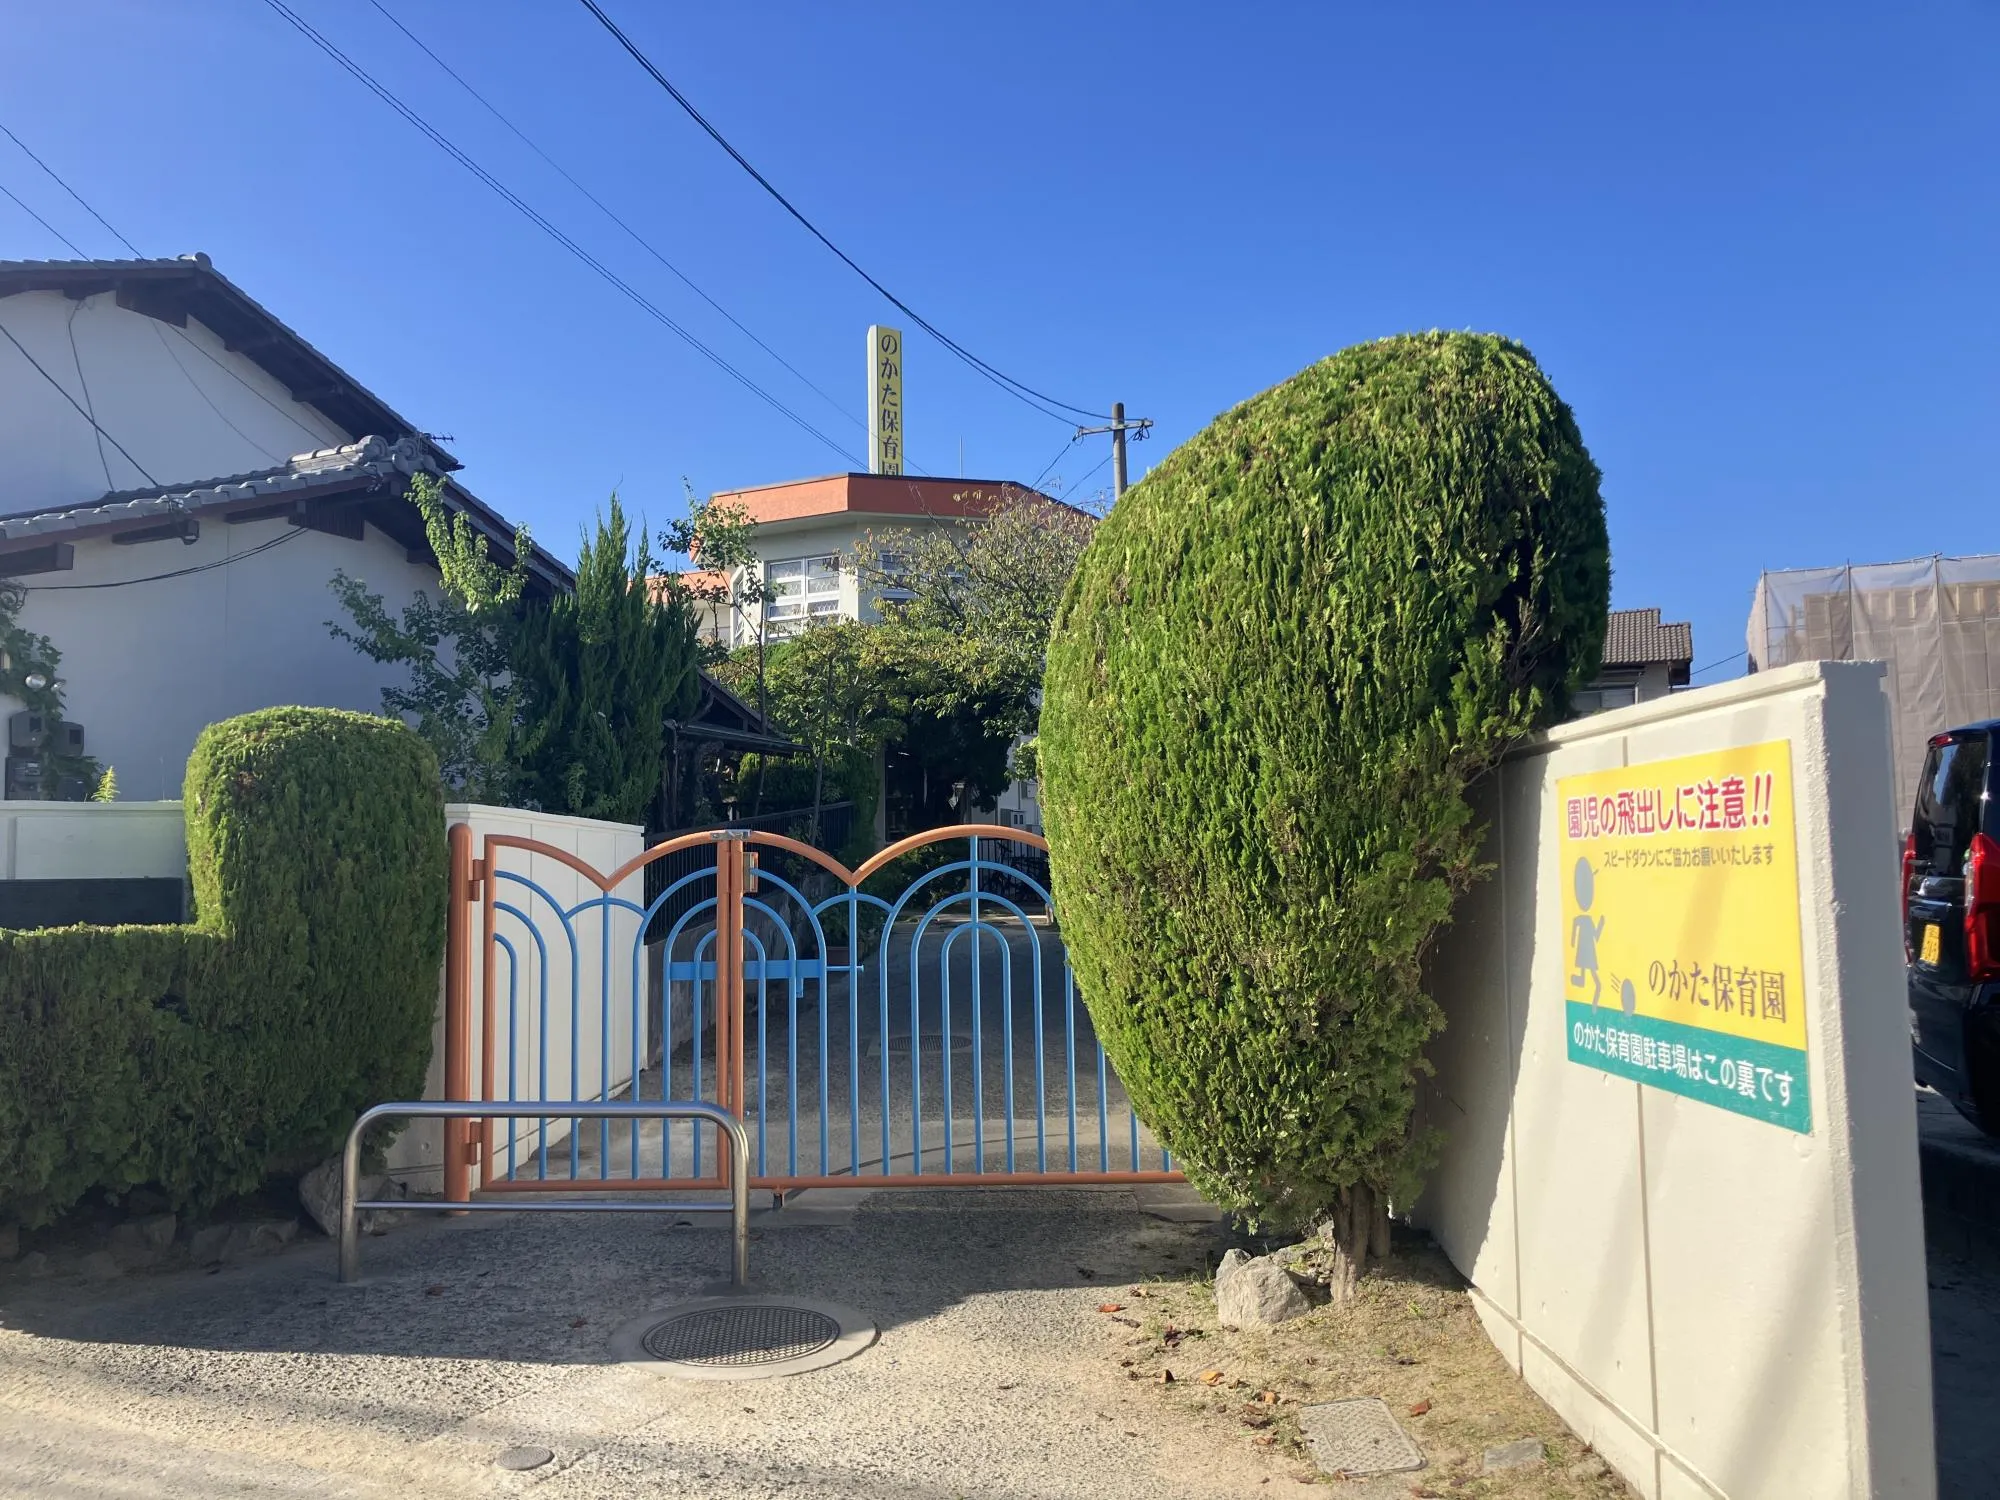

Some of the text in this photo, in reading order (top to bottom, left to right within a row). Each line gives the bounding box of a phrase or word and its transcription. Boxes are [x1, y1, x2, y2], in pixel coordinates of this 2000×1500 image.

[1568, 774, 1772, 838] 園児の飛出しに注意!!
[1604, 843, 1775, 867] スピードダウンにご協力お願いいたします
[1649, 959, 1787, 1024] のかた保育園
[1573, 1021, 1794, 1107] のかた保育園駐車場はこの裏です
